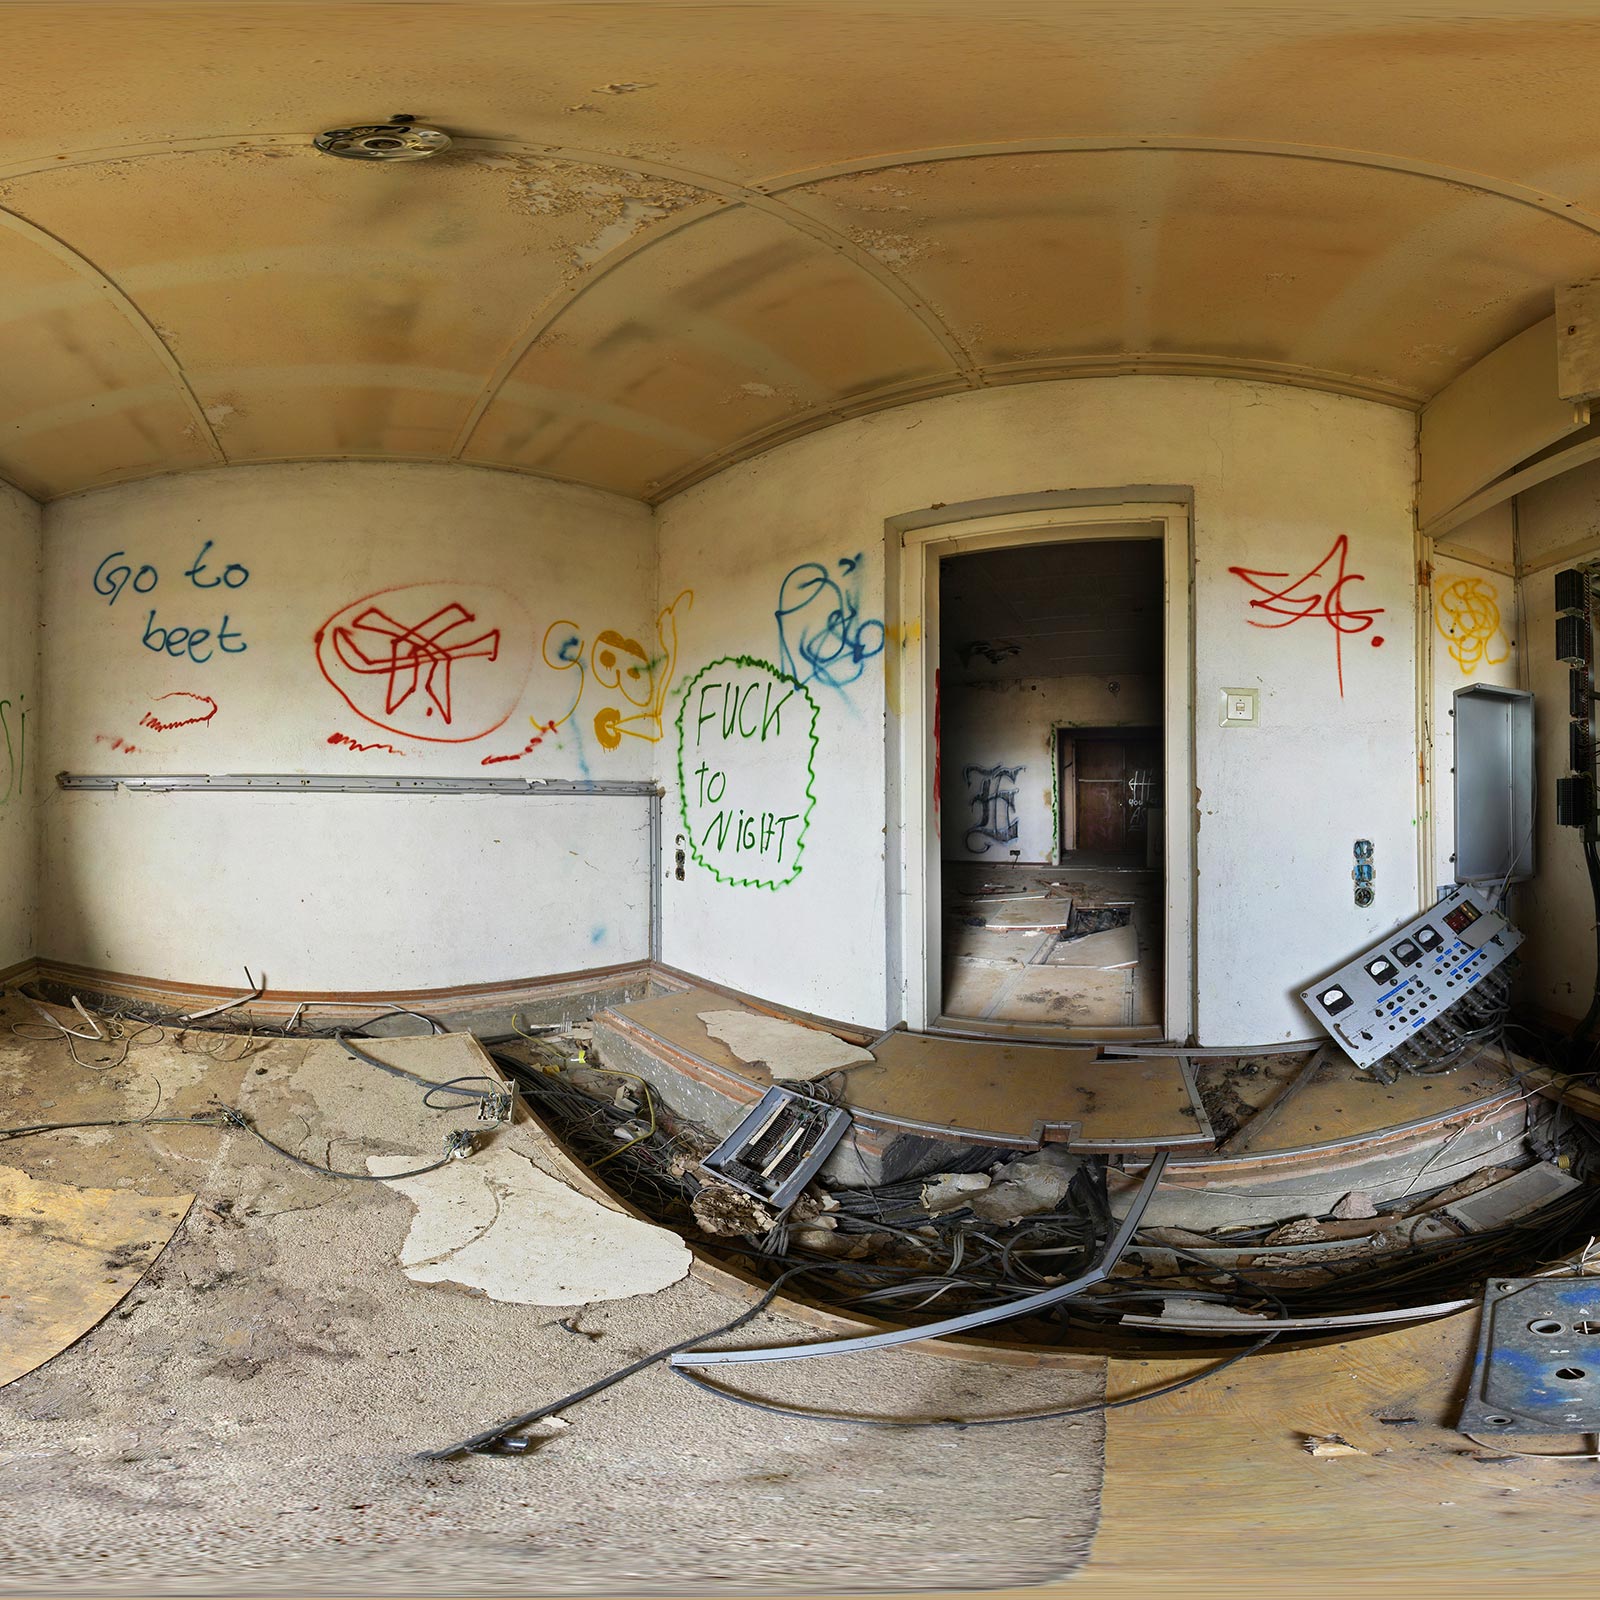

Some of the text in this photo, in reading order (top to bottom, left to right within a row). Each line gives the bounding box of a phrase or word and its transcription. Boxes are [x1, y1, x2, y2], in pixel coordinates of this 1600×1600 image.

[93, 539, 250, 607] Go to
[141, 608, 248, 664] beet
[696, 681, 795, 746] FUCK
[694, 760, 727, 808] to
